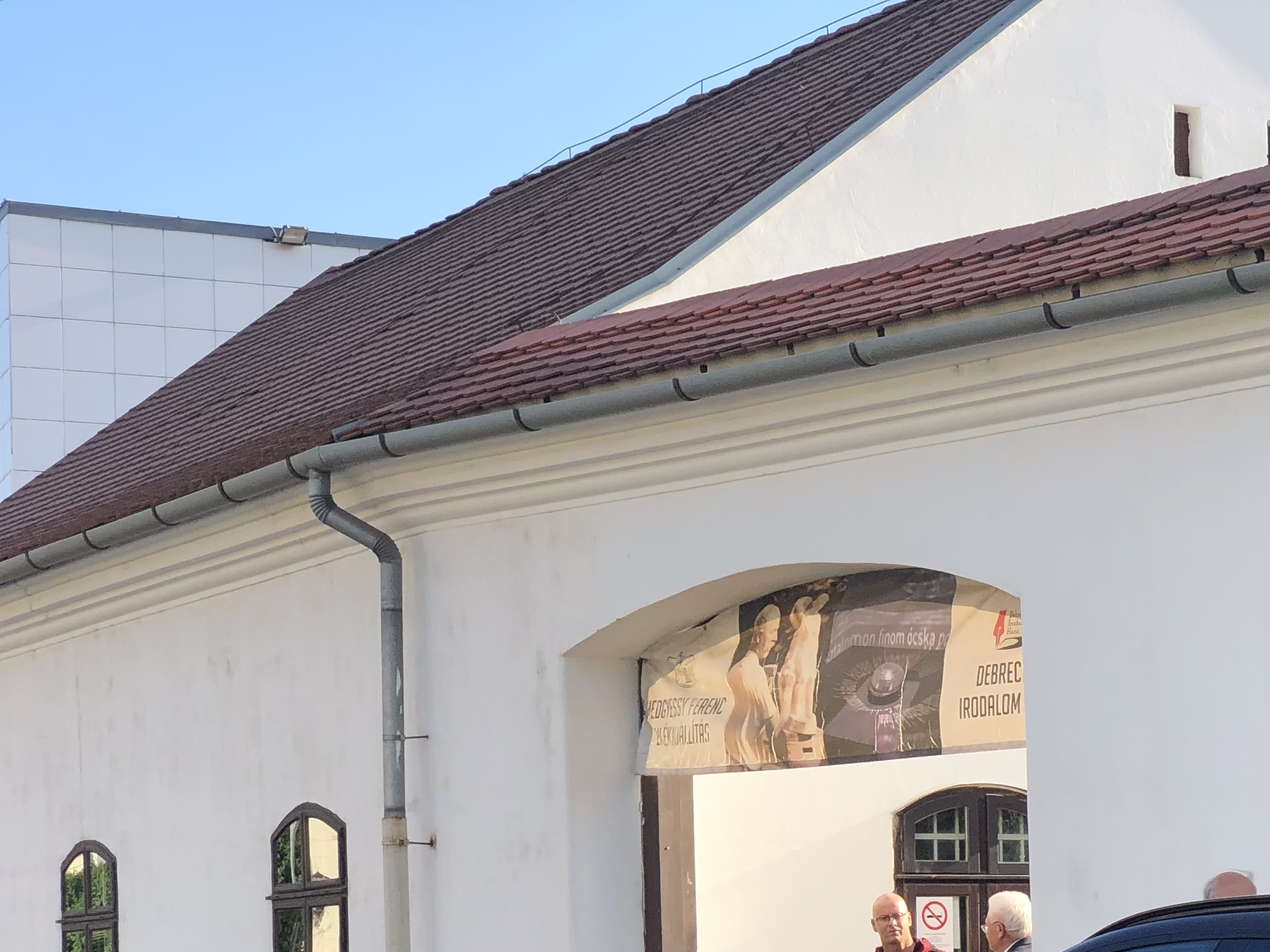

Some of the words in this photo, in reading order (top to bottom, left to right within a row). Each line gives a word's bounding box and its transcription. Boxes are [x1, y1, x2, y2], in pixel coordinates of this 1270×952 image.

[976, 661, 1022, 687] DEBREC
[688, 697, 727, 716] FERENC
[959, 692, 1021, 719] IRODALOM
